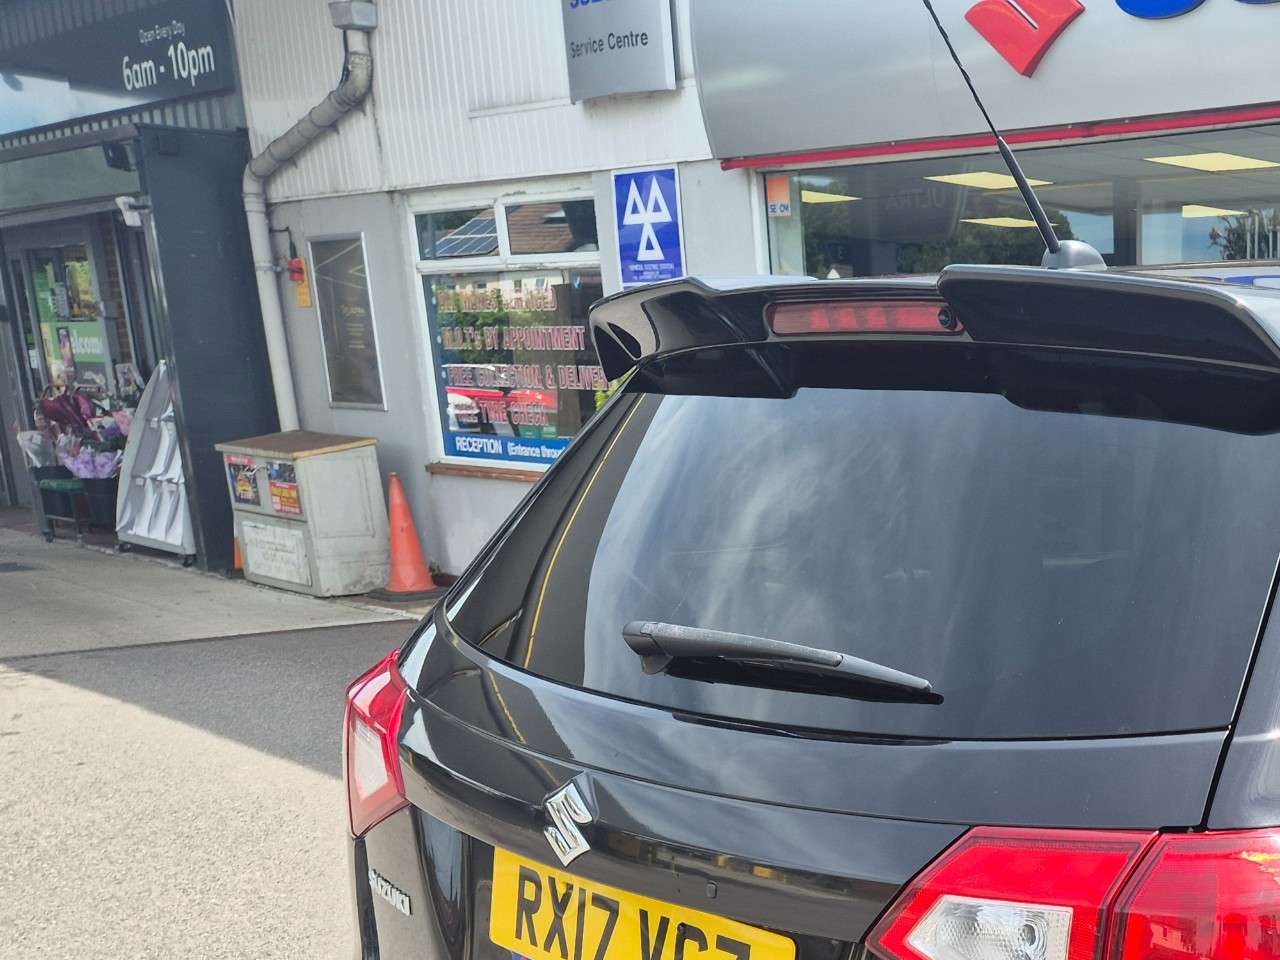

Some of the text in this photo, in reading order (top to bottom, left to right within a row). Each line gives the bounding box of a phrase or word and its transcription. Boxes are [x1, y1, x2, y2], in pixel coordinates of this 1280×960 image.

[570, 31, 648, 59] Service Centre
[122, 56, 157, 91] 6am
[167, 41, 215, 87] 10pm
[503, 325, 586, 351] APPOINTMENT
[557, 364, 609, 391] DELIVER
[456, 436, 503, 455] RECEPTION
